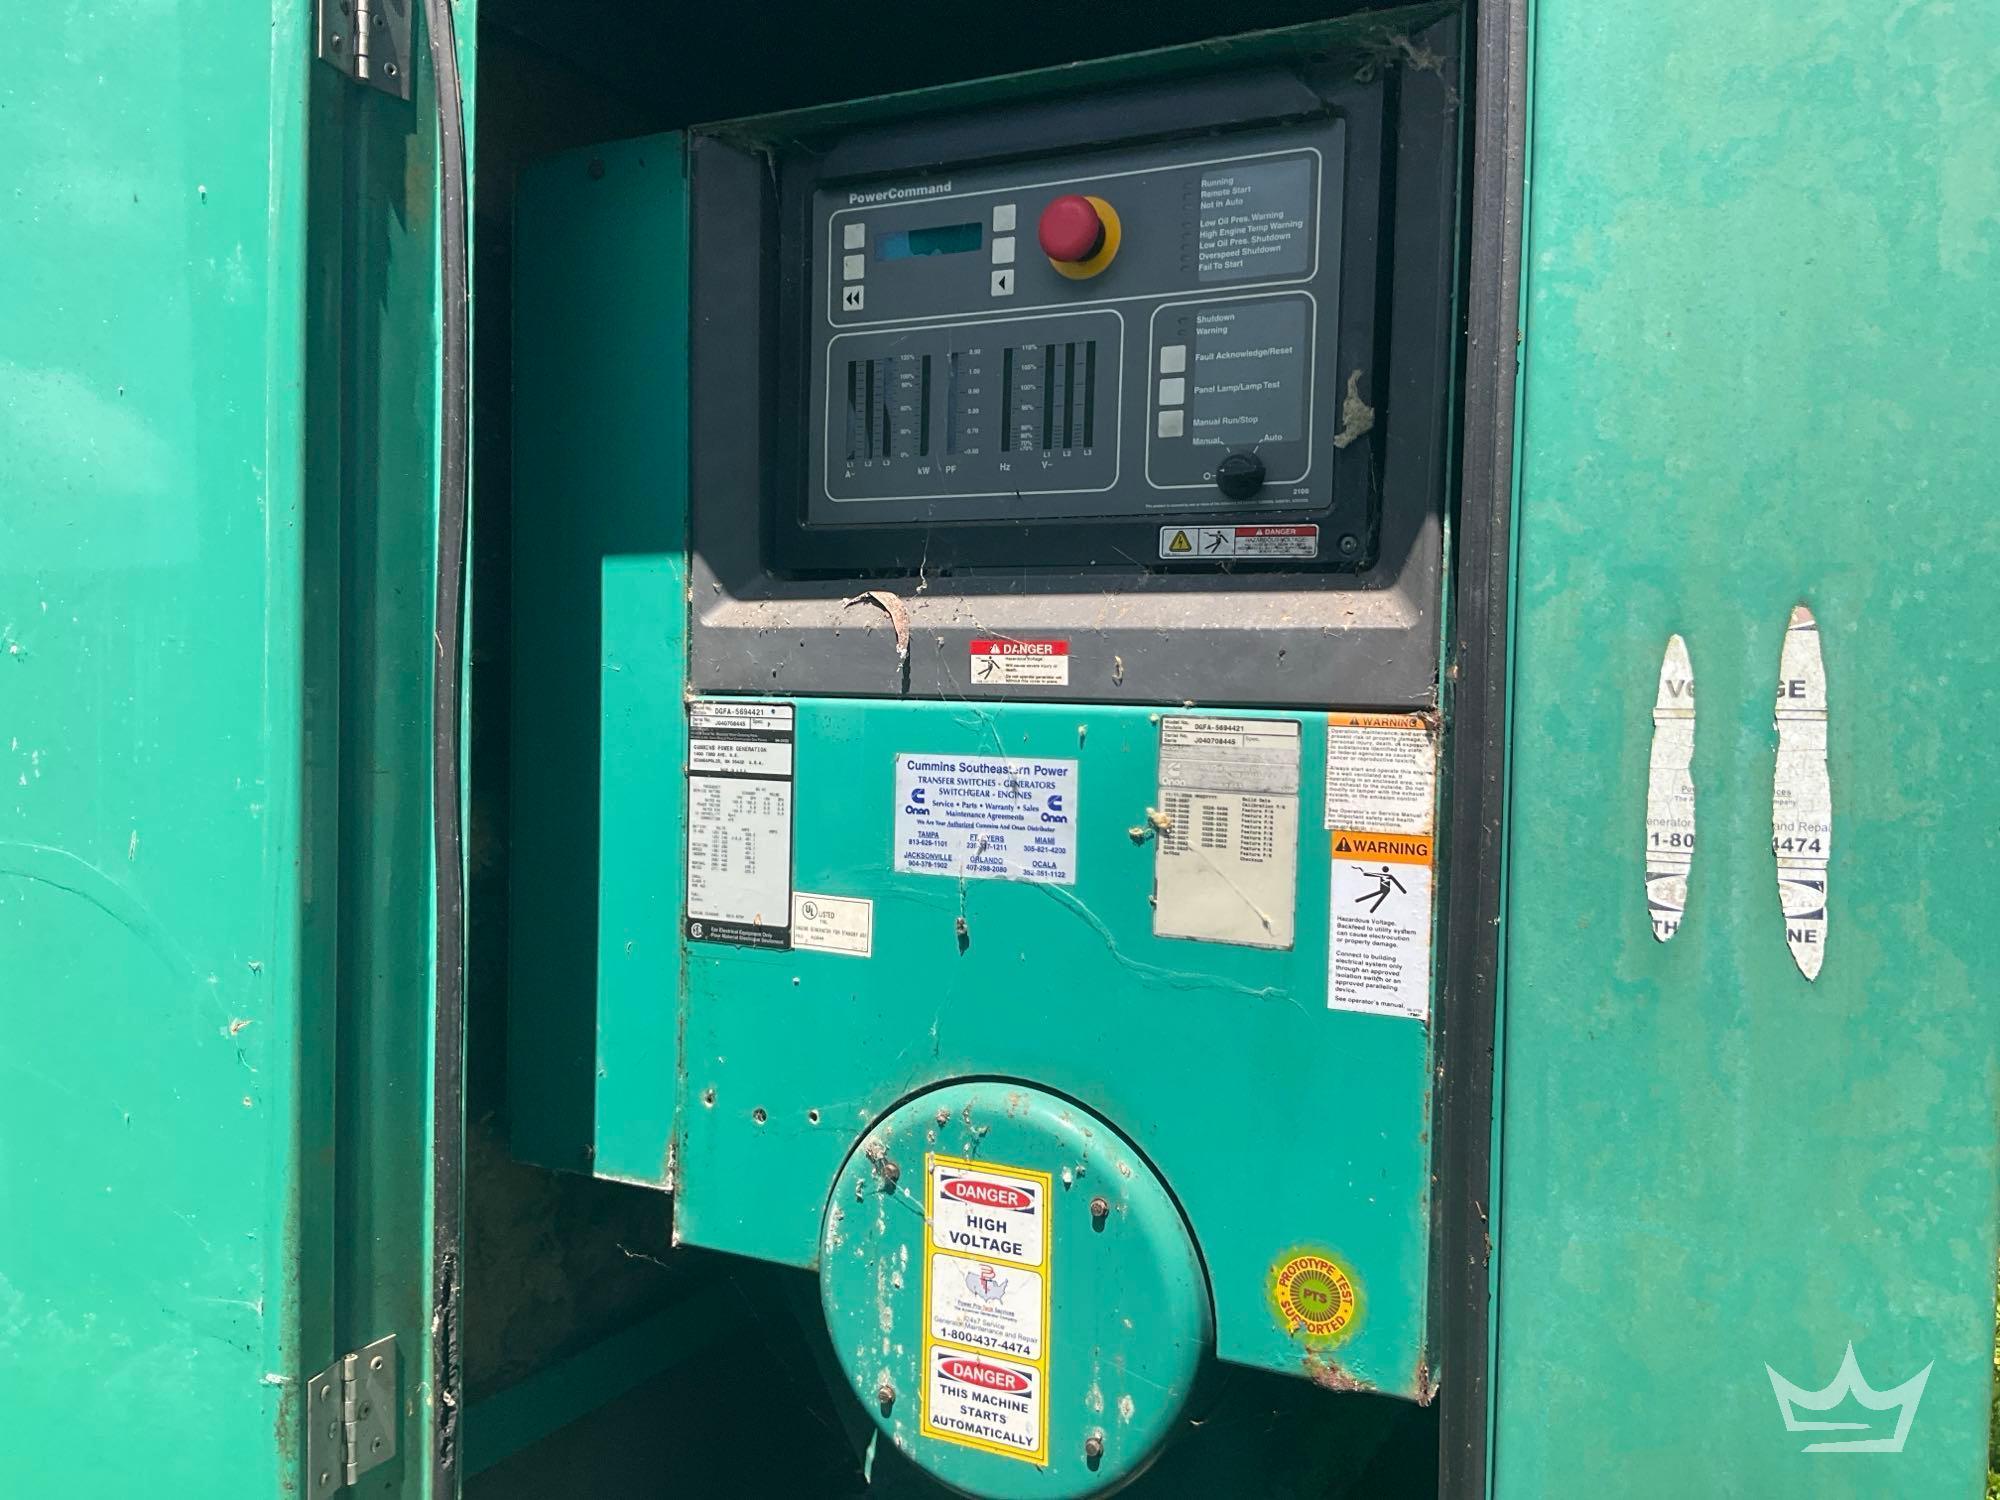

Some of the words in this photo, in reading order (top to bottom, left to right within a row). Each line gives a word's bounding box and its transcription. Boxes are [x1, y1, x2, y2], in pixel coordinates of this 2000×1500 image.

[1201, 177, 1234, 188] Running
[849, 181, 952, 204] PowerCommand
[1200, 189, 1231, 199] Remote
[1232, 186, 1252, 195] Start
[1200, 200, 1215, 209] Not
[1225, 198, 1244, 207] Auto
[1200, 219, 1216, 228] Low
[1218, 216, 1229, 225] Oil
[1251, 211, 1284, 222] Warning
[1200, 229, 1218, 240] High
[1219, 226, 1247, 237] Engine
[1248, 224, 1269, 233] Temp
[1270, 220, 1304, 231] Warning
[1199, 241, 1216, 250] Low
[1216, 239, 1228, 247] Oil
[1251, 232, 1292, 244] Shutdown
[1198, 249, 1241, 260] Overspeed
[1242, 245, 1281, 256] Shutdown
[1198, 262, 1213, 272] Fail
[1214, 261, 1223, 270] To
[1224, 259, 1244, 268] Start
[1196, 313, 1235, 324] Shutdown
[1196, 326, 1228, 336] Warning
[1195, 352, 1215, 361] Fault
[1216, 346, 1294, 360] Acknowledge/Reset
[1194, 385, 1216, 394] Panel
[1216, 382, 1263, 393] Lamp/Lamp
[1264, 380, 1280, 388] Test
[1193, 418, 1221, 427] Manual
[1222, 416, 1259, 426] Run/Stop
[1192, 436, 1220, 446] Manual
[1264, 434, 1283, 442] Auto
[918, 466, 931, 475] kW
[945, 465, 957, 474] PF
[1000, 462, 1011, 472] Hz
[1264, 528, 1297, 536] DANGER
[1004, 644, 1053, 655] DANGER
[1194, 724, 1245, 732] DGFA-5694421
[1363, 718, 1418, 728] WARNING
[907, 760, 956, 772] Cummins
[958, 762, 1030, 776] Southeasrn
[1034, 765, 1068, 777] Power
[918, 776, 955, 785] TRANSFER
[956, 778, 996, 787] SWITCHES
[1004, 780, 1056, 790] GENERATORS
[938, 788, 990, 798] SWITCHGEAR
[998, 790, 1033, 800] ENGINES
[905, 804, 930, 816] Onan
[932, 800, 955, 808] Service
[985, 802, 1015, 812] Warranty
[1023, 804, 1040, 812] Sales
[946, 810, 986, 819] Maintenance
[986, 812, 1025, 821] Agreements
[1041, 812, 1068, 824] Onan
[918, 830, 940, 839] TAMPA
[970, 833, 980, 842] FT.
[1034, 836, 1056, 845] MIAMI
[1650, 832, 1695, 848] 1-80
[1354, 839, 1428, 857] WARNING
[904, 852, 953, 862] JACKSONVILLE
[970, 856, 1004, 865] ORLANDO
[1032, 860, 1057, 870] OCALA
[1337, 916, 1370, 924] Hazardous
[1371, 918, 1397, 927] Voltage.
[1336, 922, 1366, 931] Backfeed
[1374, 926, 1392, 934] utility
[1369, 932, 1410, 942] electrocution
[1788, 928, 1817, 944] NE
[1344, 938, 1371, 946] property
[1372, 940, 1399, 949] damage.
[1336, 950, 1362, 958] Connect
[1370, 953, 1397, 963] building
[1336, 958, 1364, 966] electrical
[1365, 960, 1388, 968] system
[1336, 965, 1360, 973] through
[1370, 968, 1400, 977] approved
[1336, 971, 1362, 980] isolation
[1335, 986, 1357, 994] device.
[1366, 982, 1398, 992] paralleling
[1335, 994, 1347, 1002] See
[1348, 997, 1380, 1006] operator's
[1380, 1001, 1406, 1009] manual.
[956, 1184, 1019, 1207] DANGER
[966, 1214, 1007, 1234] HIGH
[949, 1230, 1023, 1256] VOLTAGE
[1278, 1258, 1336, 1288] PROTOTYPE
[1335, 1274, 1354, 1307] TEST
[1303, 1288, 1328, 1304] PTS
[982, 1318, 1005, 1330] Service
[940, 1327, 1031, 1356] 1-800-437-4474
[1005, 1330, 1017, 1339] and
[1018, 1332, 1038, 1344] Repair
[954, 1362, 1016, 1389] DANGER
[940, 1384, 969, 1399] THIS
[972, 1391, 1029, 1414] MACHINE
[960, 1405, 1008, 1425] STARTS
[932, 1414, 1034, 1447] AUTOMATICALLY
